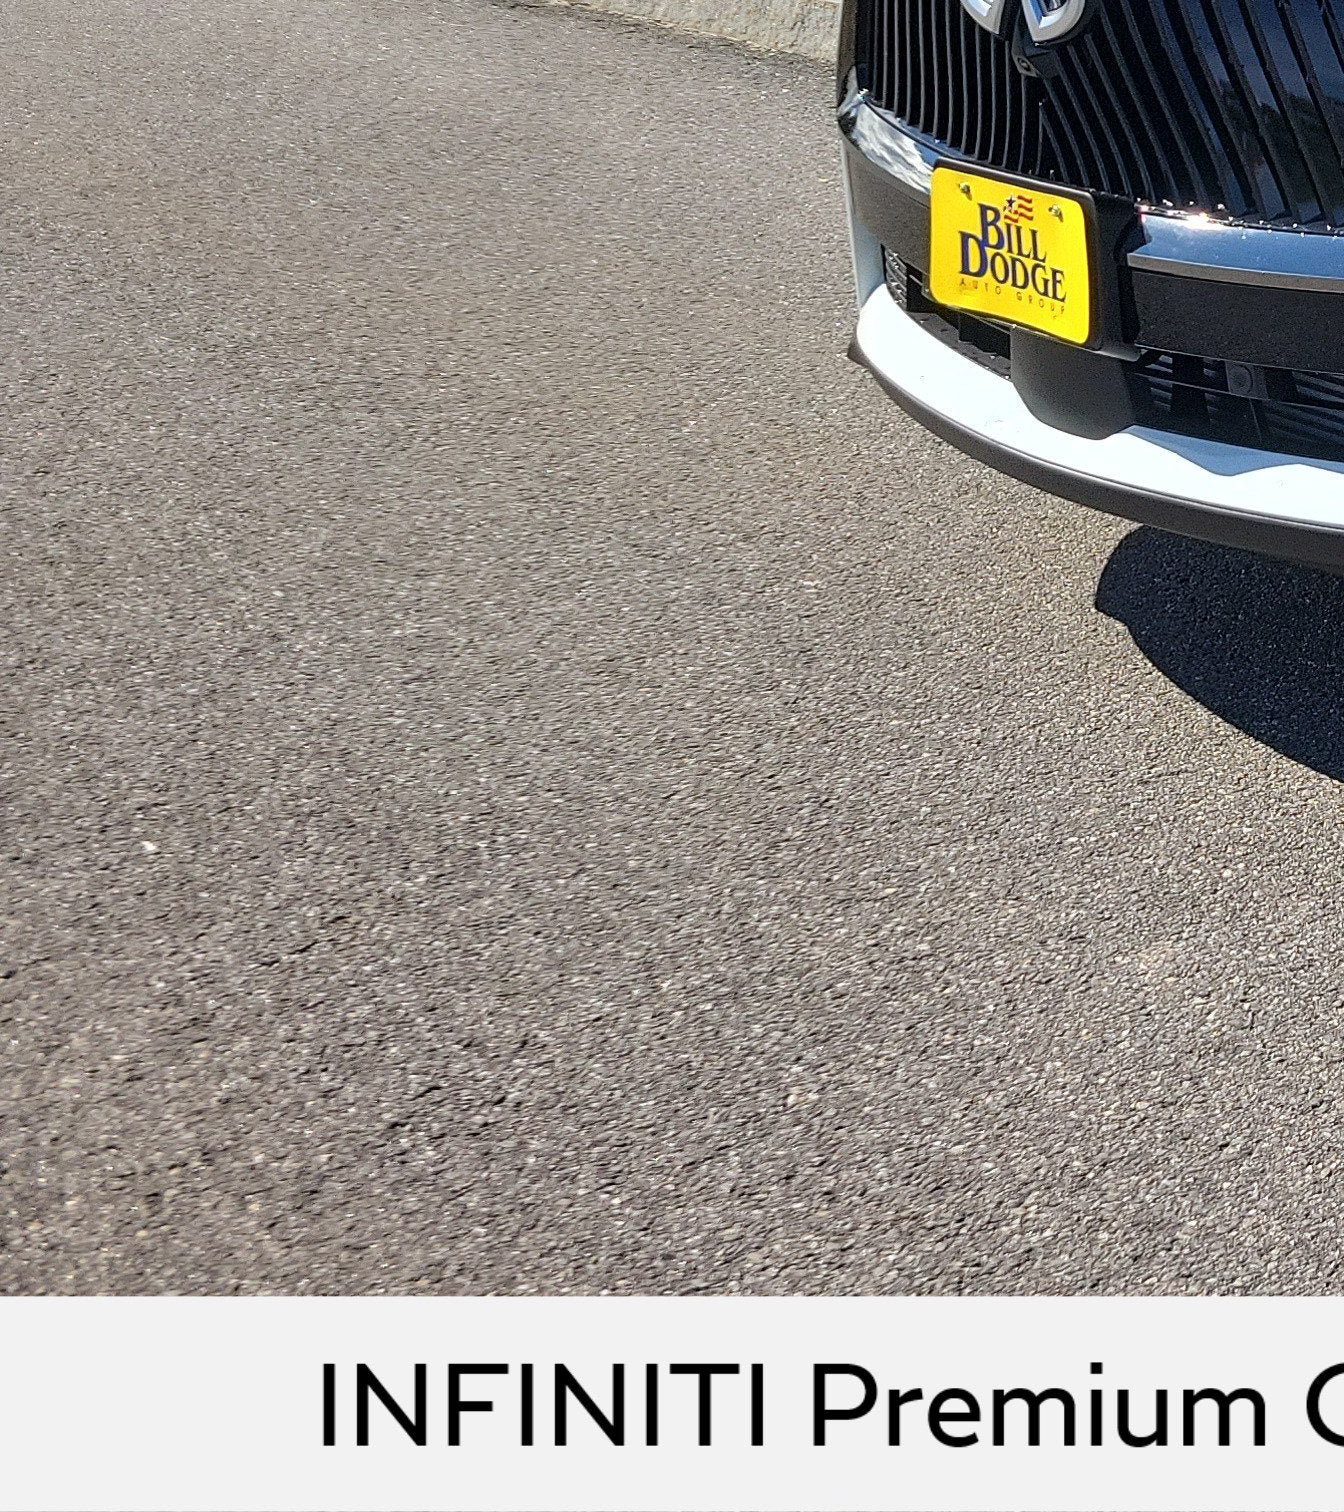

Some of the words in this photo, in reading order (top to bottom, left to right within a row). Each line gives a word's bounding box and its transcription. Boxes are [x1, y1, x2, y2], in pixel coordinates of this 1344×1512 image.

[977, 202, 1047, 264] BILL
[958, 230, 1067, 303] DODGE
[1015, 291, 1066, 315] GROUP
